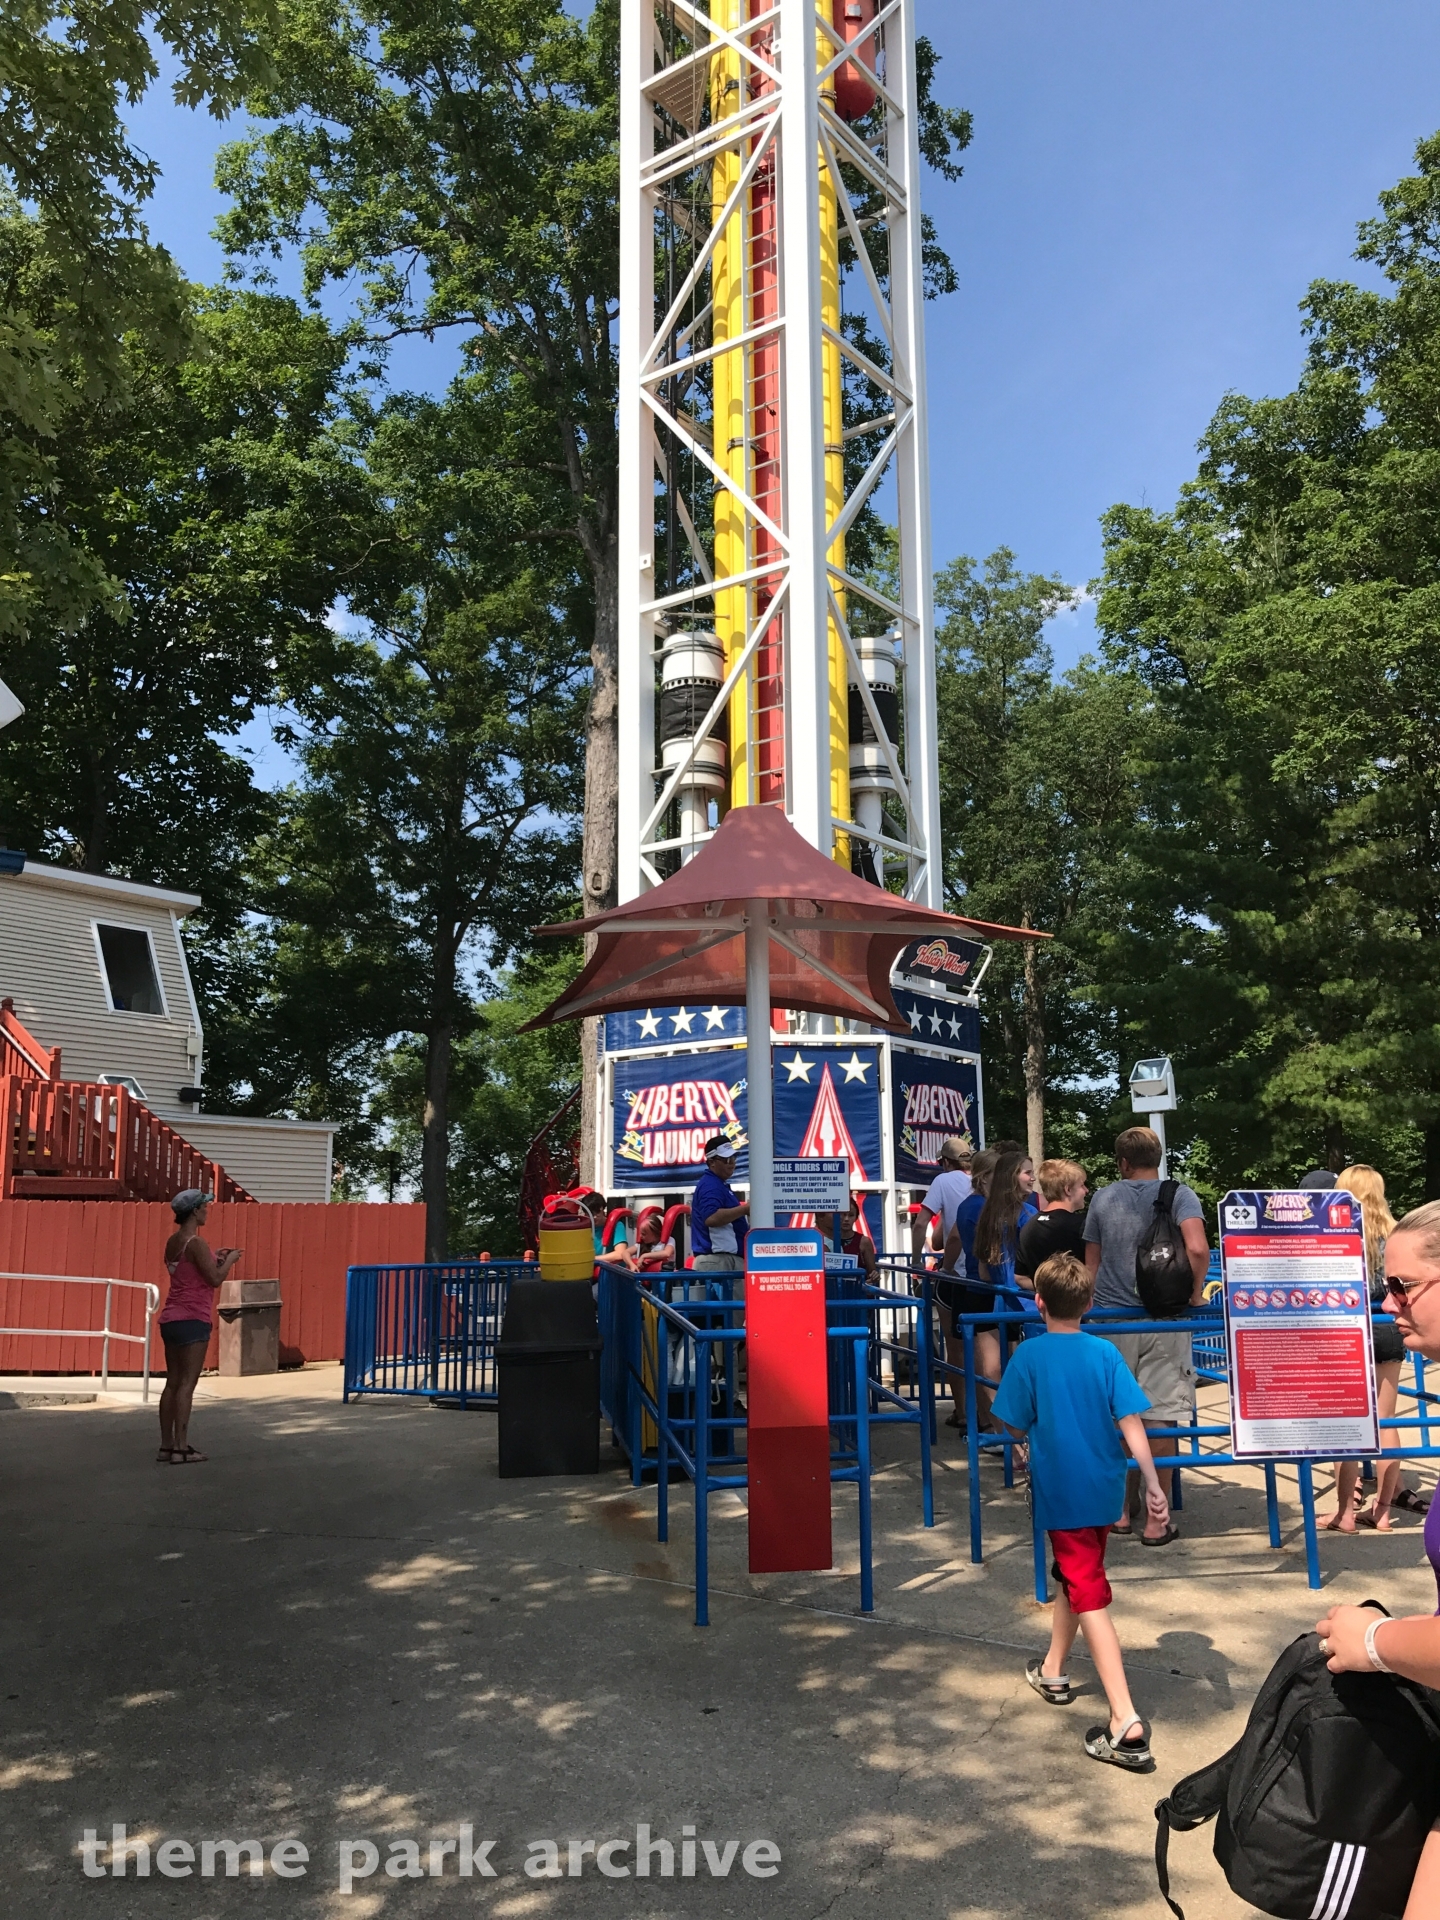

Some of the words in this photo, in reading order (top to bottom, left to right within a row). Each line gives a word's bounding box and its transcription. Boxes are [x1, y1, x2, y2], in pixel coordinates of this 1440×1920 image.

[910, 944, 945, 973] Holiday
[942, 952, 971, 976] World
[625, 1079, 740, 1131] LIBERTY
[903, 1084, 971, 1132] LIBERTY
[642, 1127, 720, 1167] LAUNC
[773, 1163, 792, 1172] INGLE
[795, 1163, 820, 1172] RIDERS
[823, 1163, 840, 1172] ONLY
[1266, 1194, 1310, 1208] LIBERTY
[1273, 1210, 1304, 1222] LAUNCH
[755, 1246, 776, 1254] SINGLE
[800, 1245, 814, 1253] ONLY
